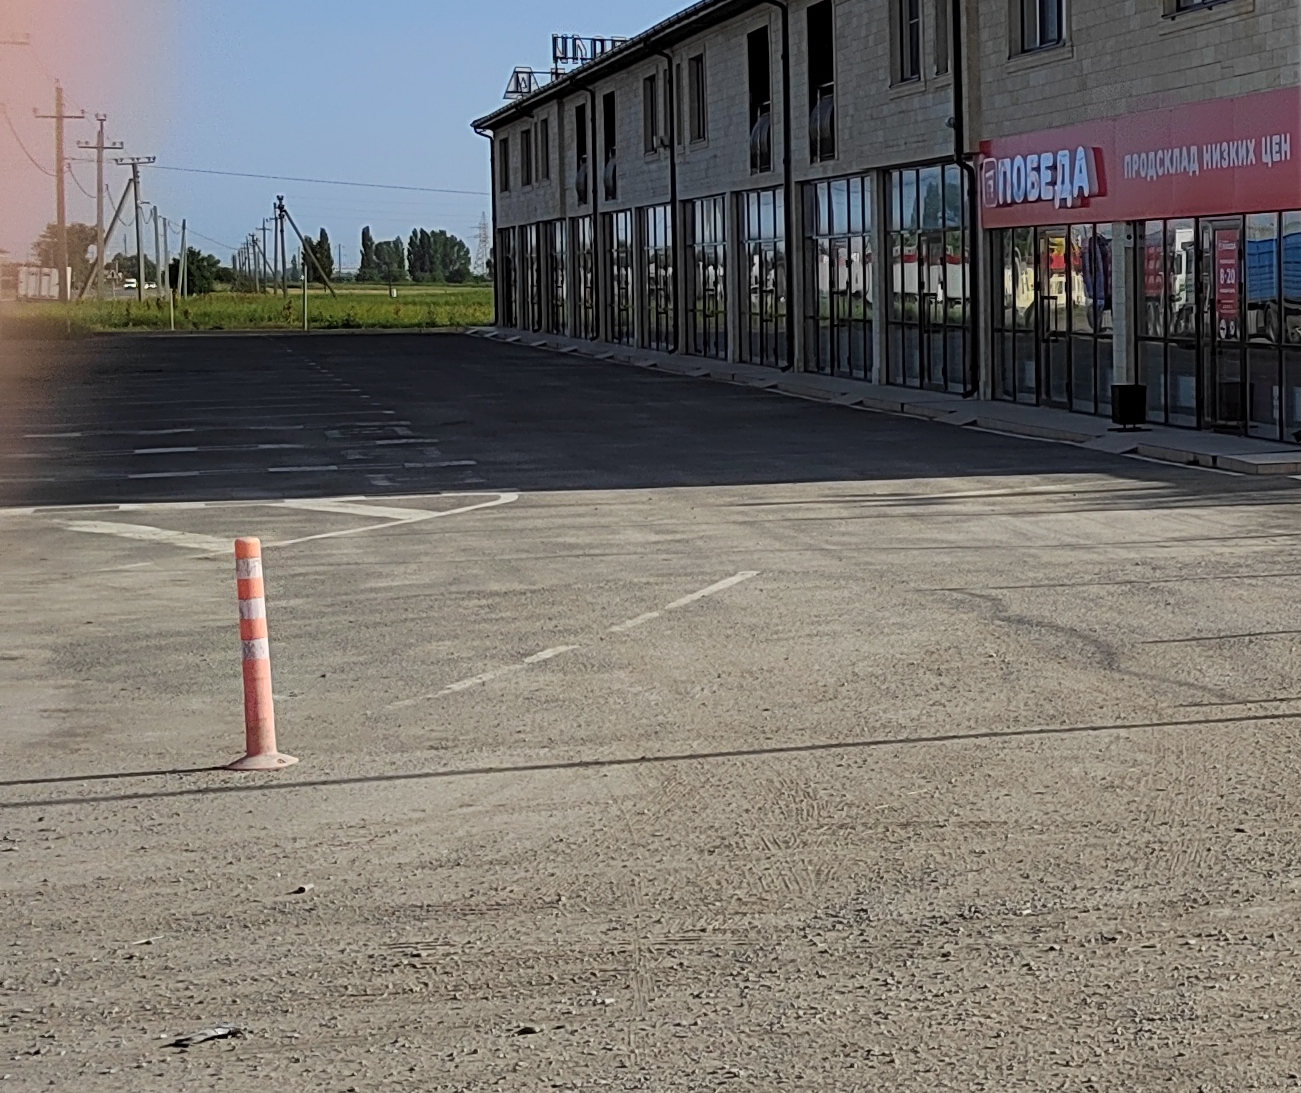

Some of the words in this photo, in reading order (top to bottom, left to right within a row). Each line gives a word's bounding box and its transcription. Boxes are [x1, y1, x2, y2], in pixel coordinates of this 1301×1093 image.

[998, 146, 1089, 209] ПОБЕДА
[1124, 146, 1199, 181] ПРОДСКЛАД
[1203, 139, 1255, 168] НИЗКИХ
[1262, 133, 1291, 168] ЦЕН
